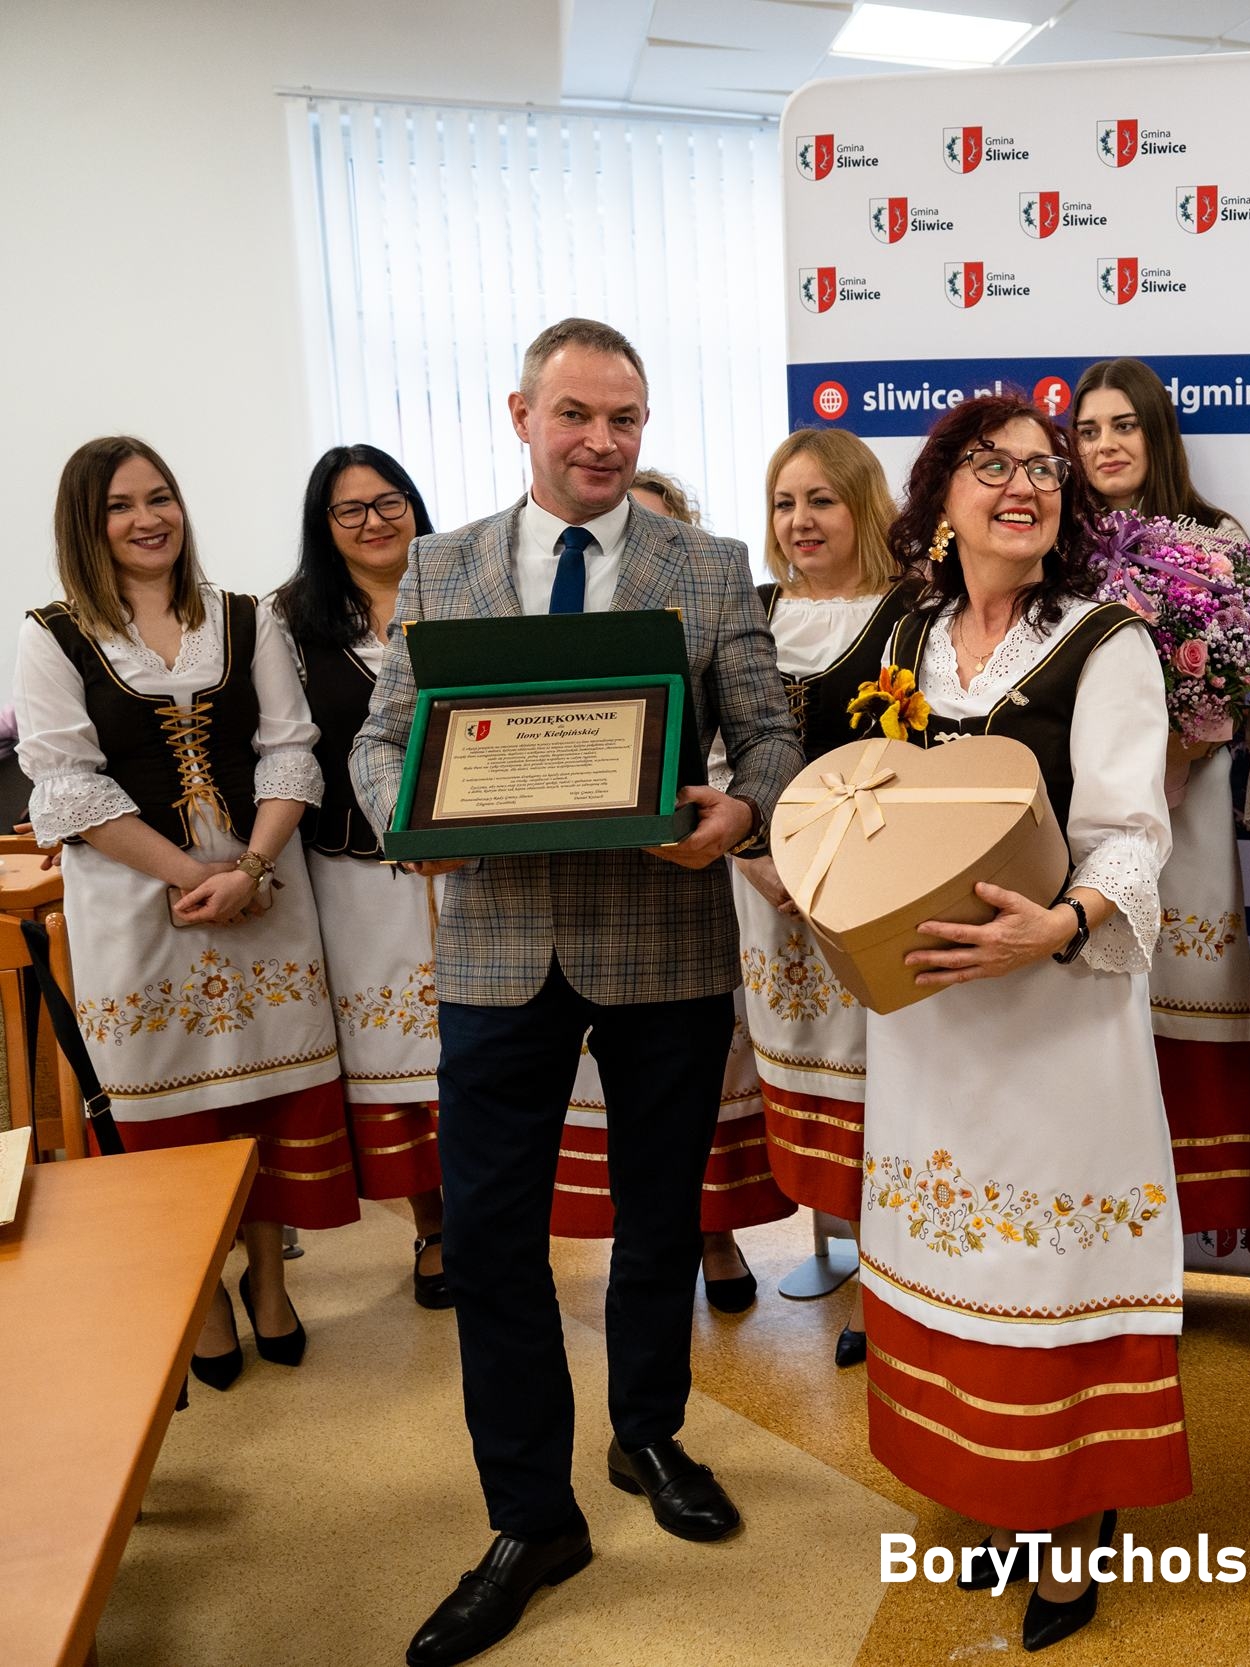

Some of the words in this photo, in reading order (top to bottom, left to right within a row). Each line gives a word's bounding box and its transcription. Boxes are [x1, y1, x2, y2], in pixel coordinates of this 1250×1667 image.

[1141, 130, 1170, 139] Gmina
[986, 137, 1014, 146] Gmina
[837, 144, 864, 154] Gmina
[1141, 141, 1186, 155] Śliwice
[986, 148, 1029, 162] Śliwice
[837, 154, 878, 169] Śliwice
[1221, 196, 1250, 206] Gmina
[1063, 202, 1091, 211] Gmina
[911, 208, 938, 216] Gmina
[1063, 213, 1107, 227] Śliwice
[911, 218, 953, 233] Śliwice
[987, 272, 1015, 281] Gmina
[1141, 268, 1170, 277] Gmina
[839, 277, 866, 286] Gmina
[1141, 279, 1186, 293] Śliwice
[840, 288, 880, 302] Śliwice
[987, 283, 1030, 297] Śliwice
[506, 711, 618, 727] PODZIĘKOWANIE
[516, 732, 541, 741] Ilony
